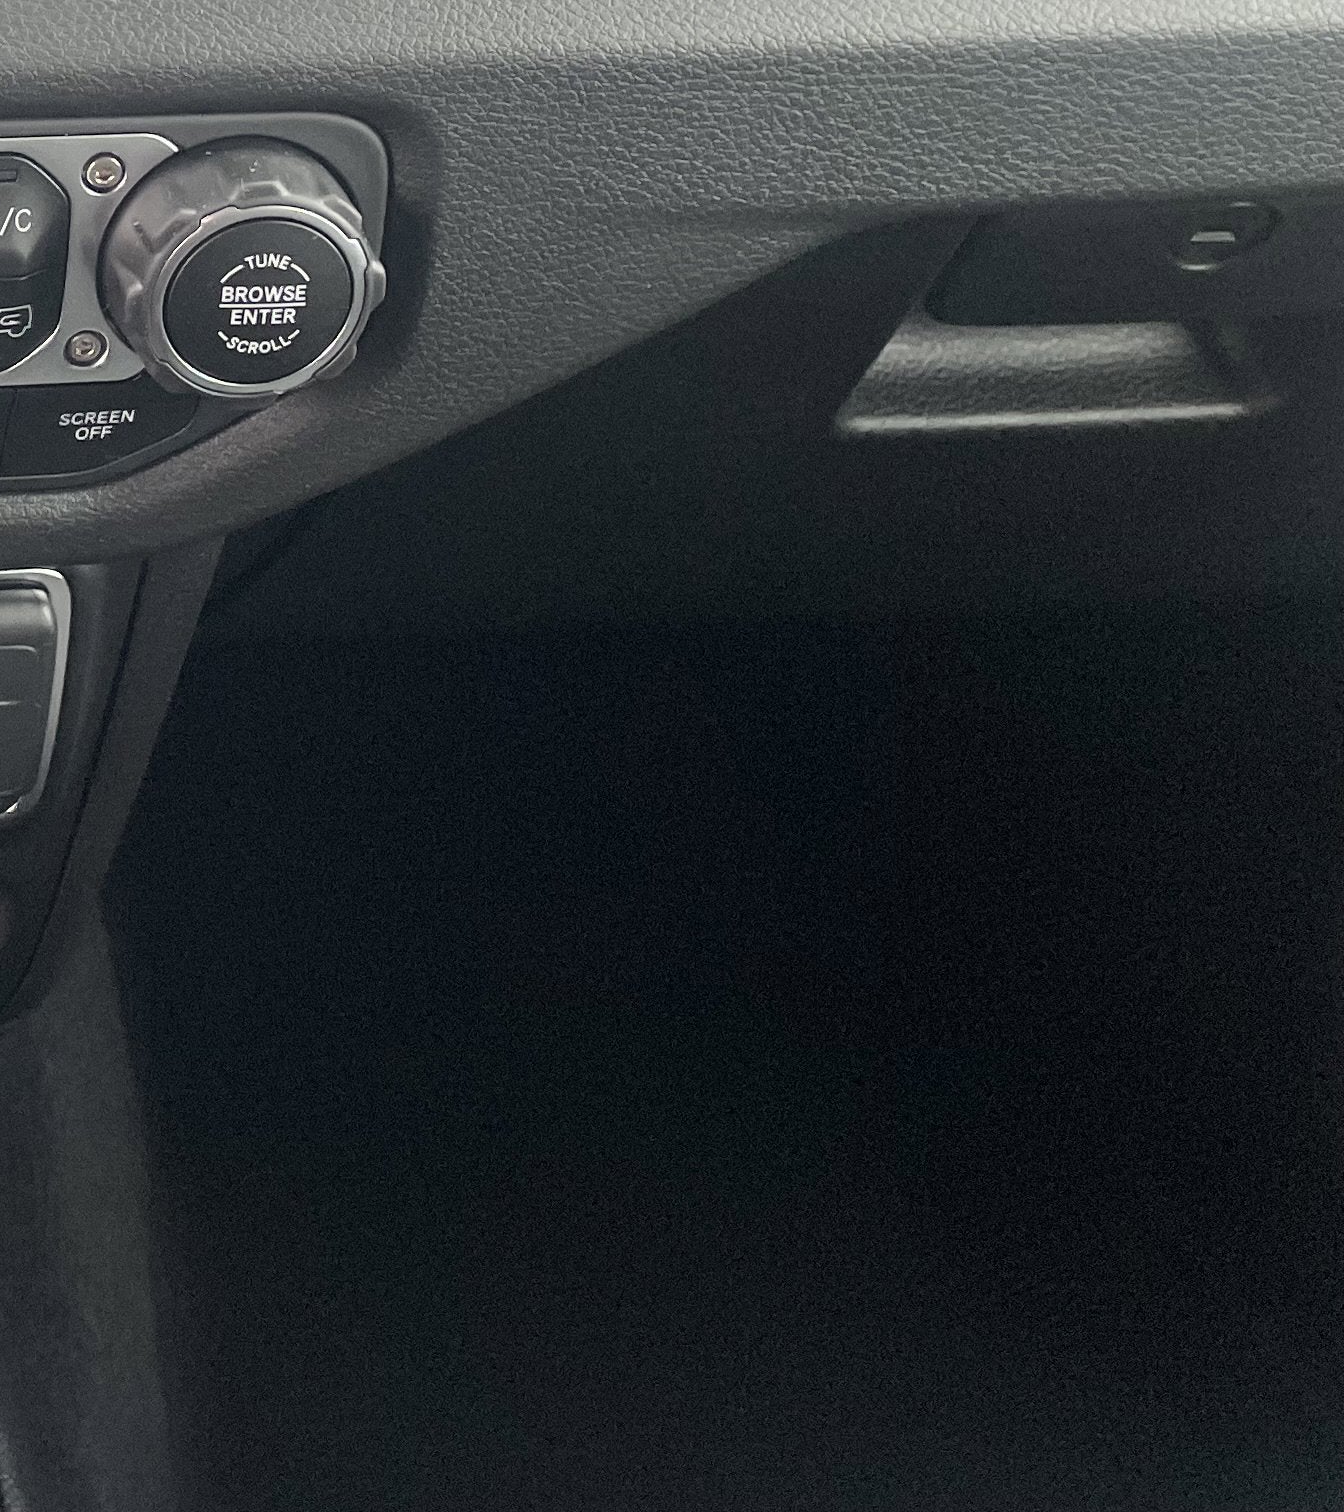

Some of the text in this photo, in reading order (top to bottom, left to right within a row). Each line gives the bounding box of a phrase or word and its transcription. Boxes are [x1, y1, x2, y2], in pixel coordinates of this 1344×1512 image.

[244, 253, 292, 270] TUNE
[221, 285, 307, 302] BROWSE
[230, 308, 296, 325] ENTER
[226, 336, 292, 354] SCROLL
[58, 409, 135, 426] SCREEN
[75, 425, 113, 440] OFF
